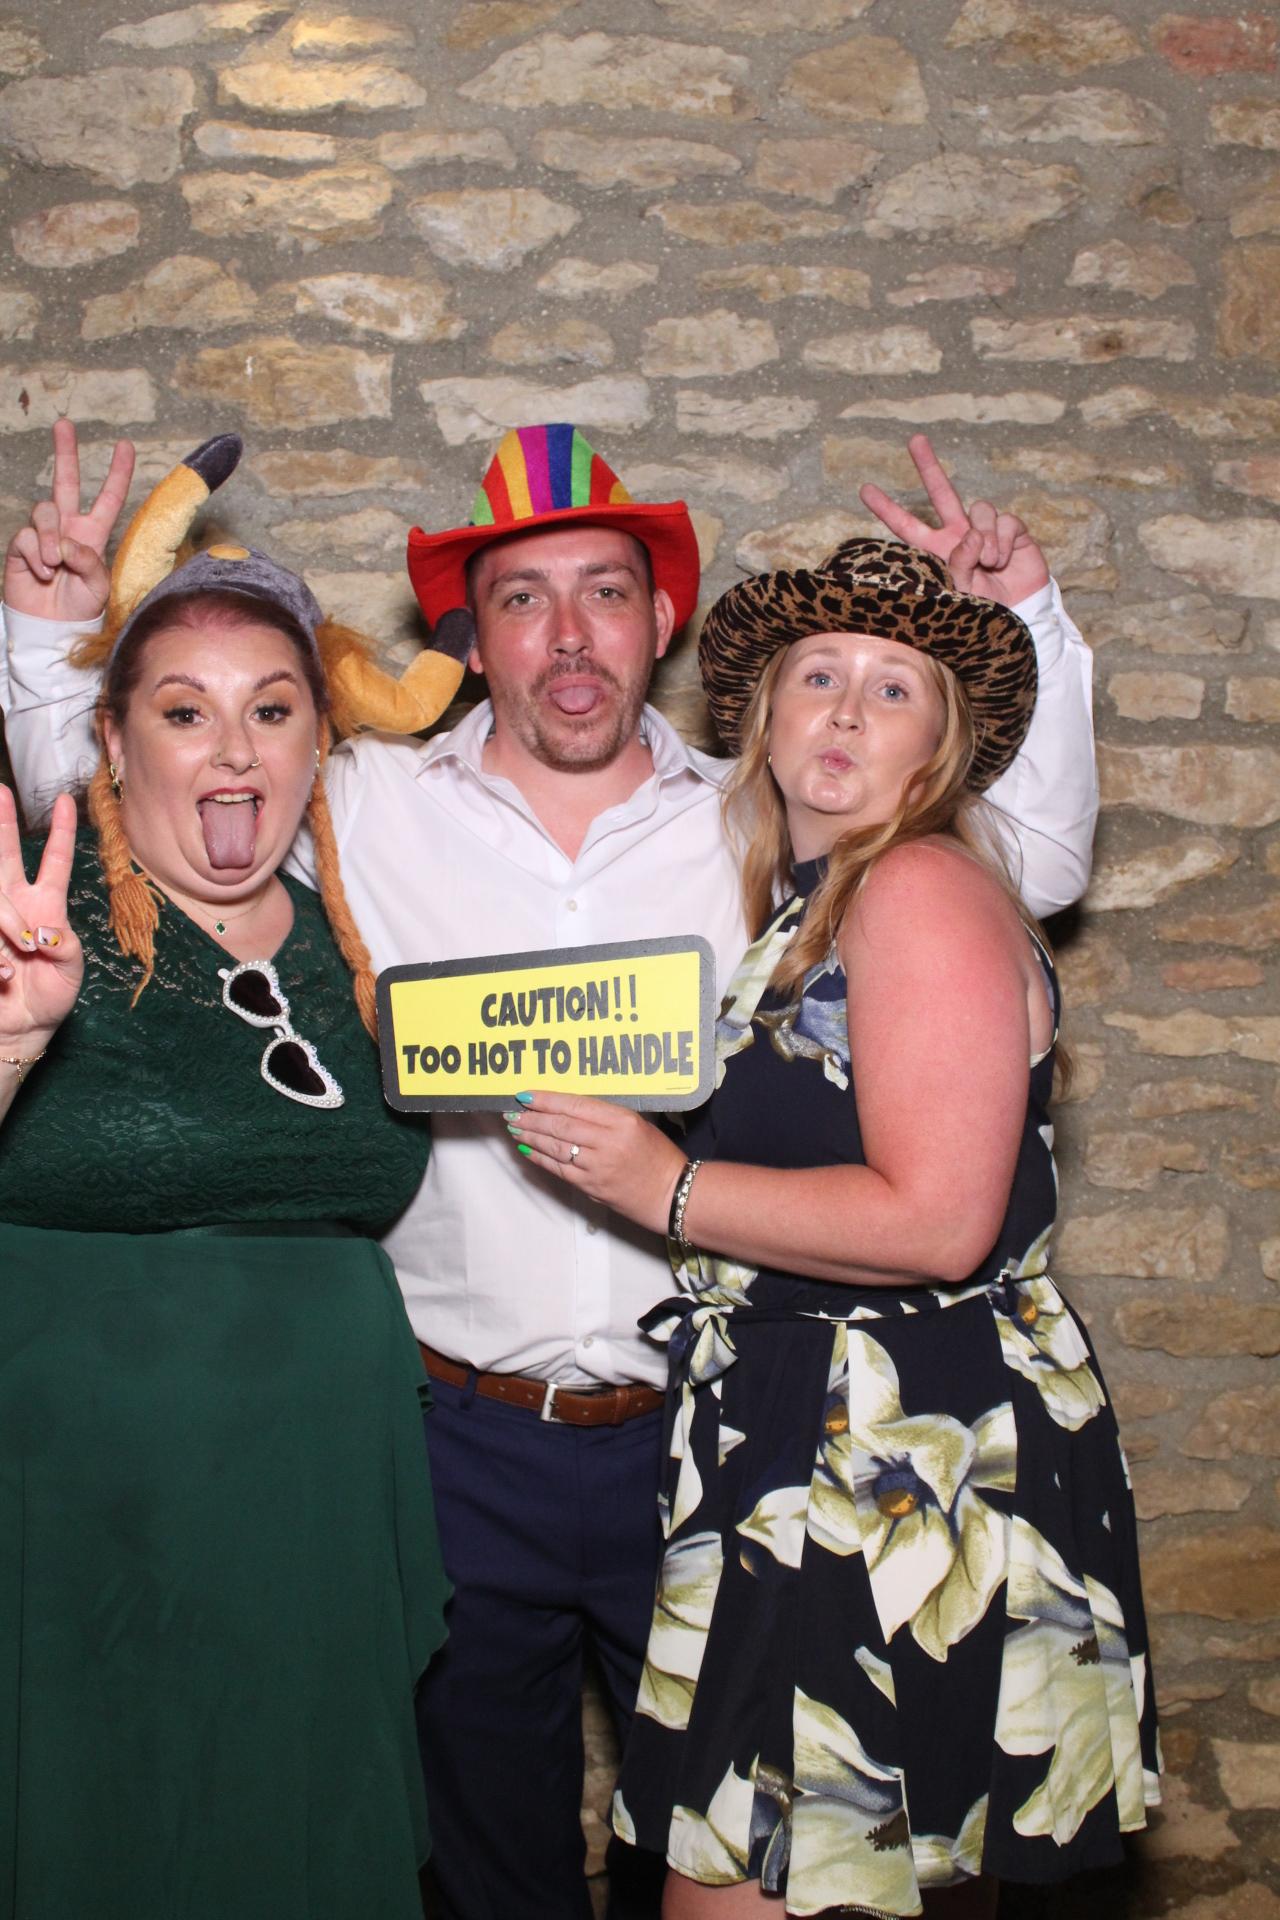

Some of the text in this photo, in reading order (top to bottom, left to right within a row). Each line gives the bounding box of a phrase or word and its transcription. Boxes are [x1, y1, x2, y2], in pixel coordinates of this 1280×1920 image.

[480, 974, 638, 1028] CAUTION!!
[402, 1030, 694, 1076] TOO HOT TO HANDLE
